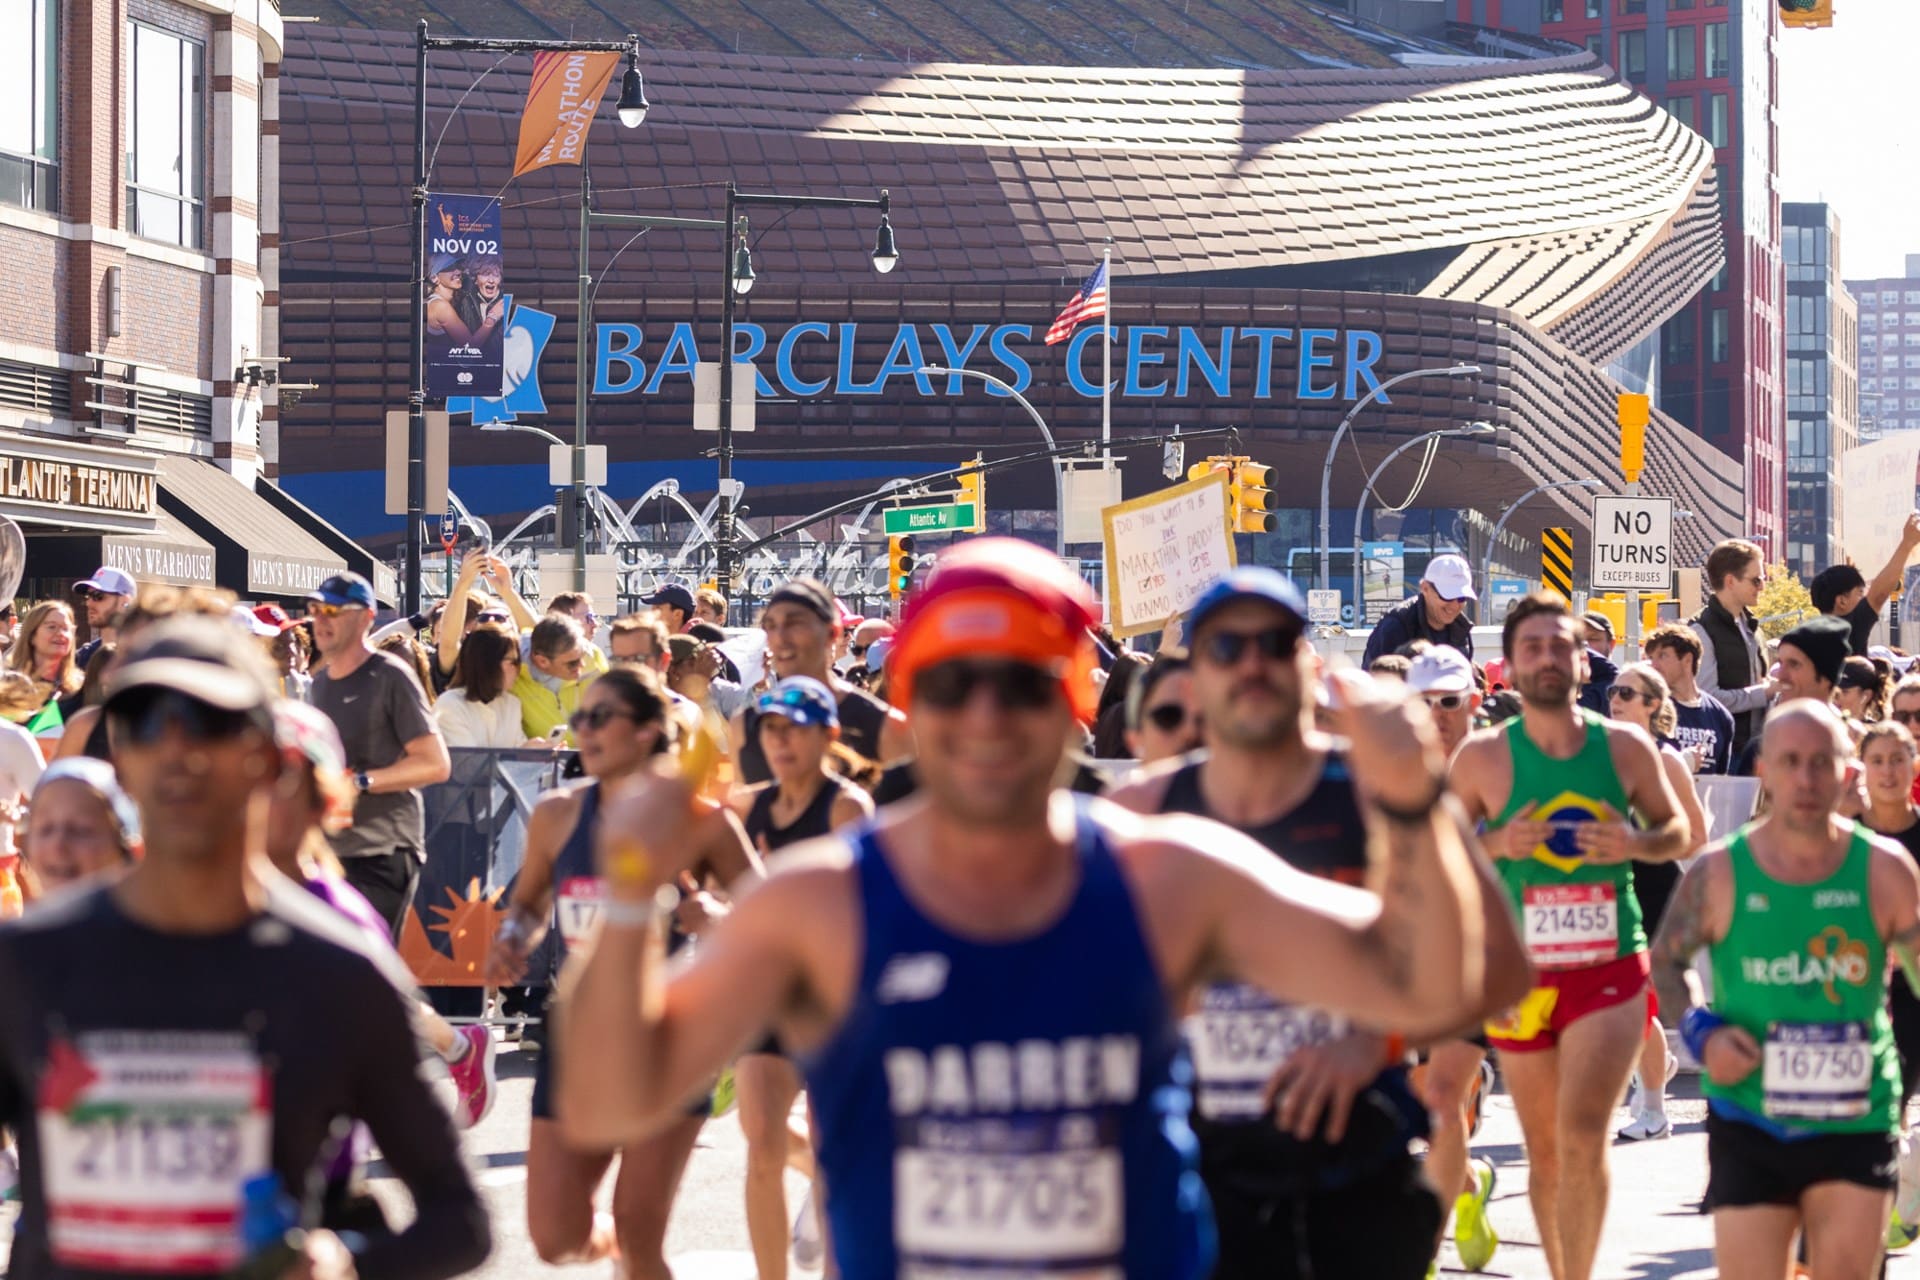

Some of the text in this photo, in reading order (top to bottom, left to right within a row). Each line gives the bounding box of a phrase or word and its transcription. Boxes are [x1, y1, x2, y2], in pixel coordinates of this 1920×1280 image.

[537, 55, 587, 163] MATHON
[559, 99, 595, 159] ROUTE
[433, 238, 498, 255] NOV 02
[592, 321, 1393, 405] BARCLAYS CENTER
[909, 511, 947, 528] Atlantic Av
[1614, 510, 1652, 535] NO
[107, 544, 212, 581] MEN'S WEARHOUSE
[1598, 544, 1667, 564] TURNS
[252, 559, 345, 590] MEN'S WEARHO
[1603, 571, 1661, 582] EXCEPT BUSES
[1535, 904, 1609, 934] 21455
[884, 1034, 1141, 1117] DARREN
[1777, 1049, 1864, 1080] 16750
[924, 1155, 1104, 1231] 21705
